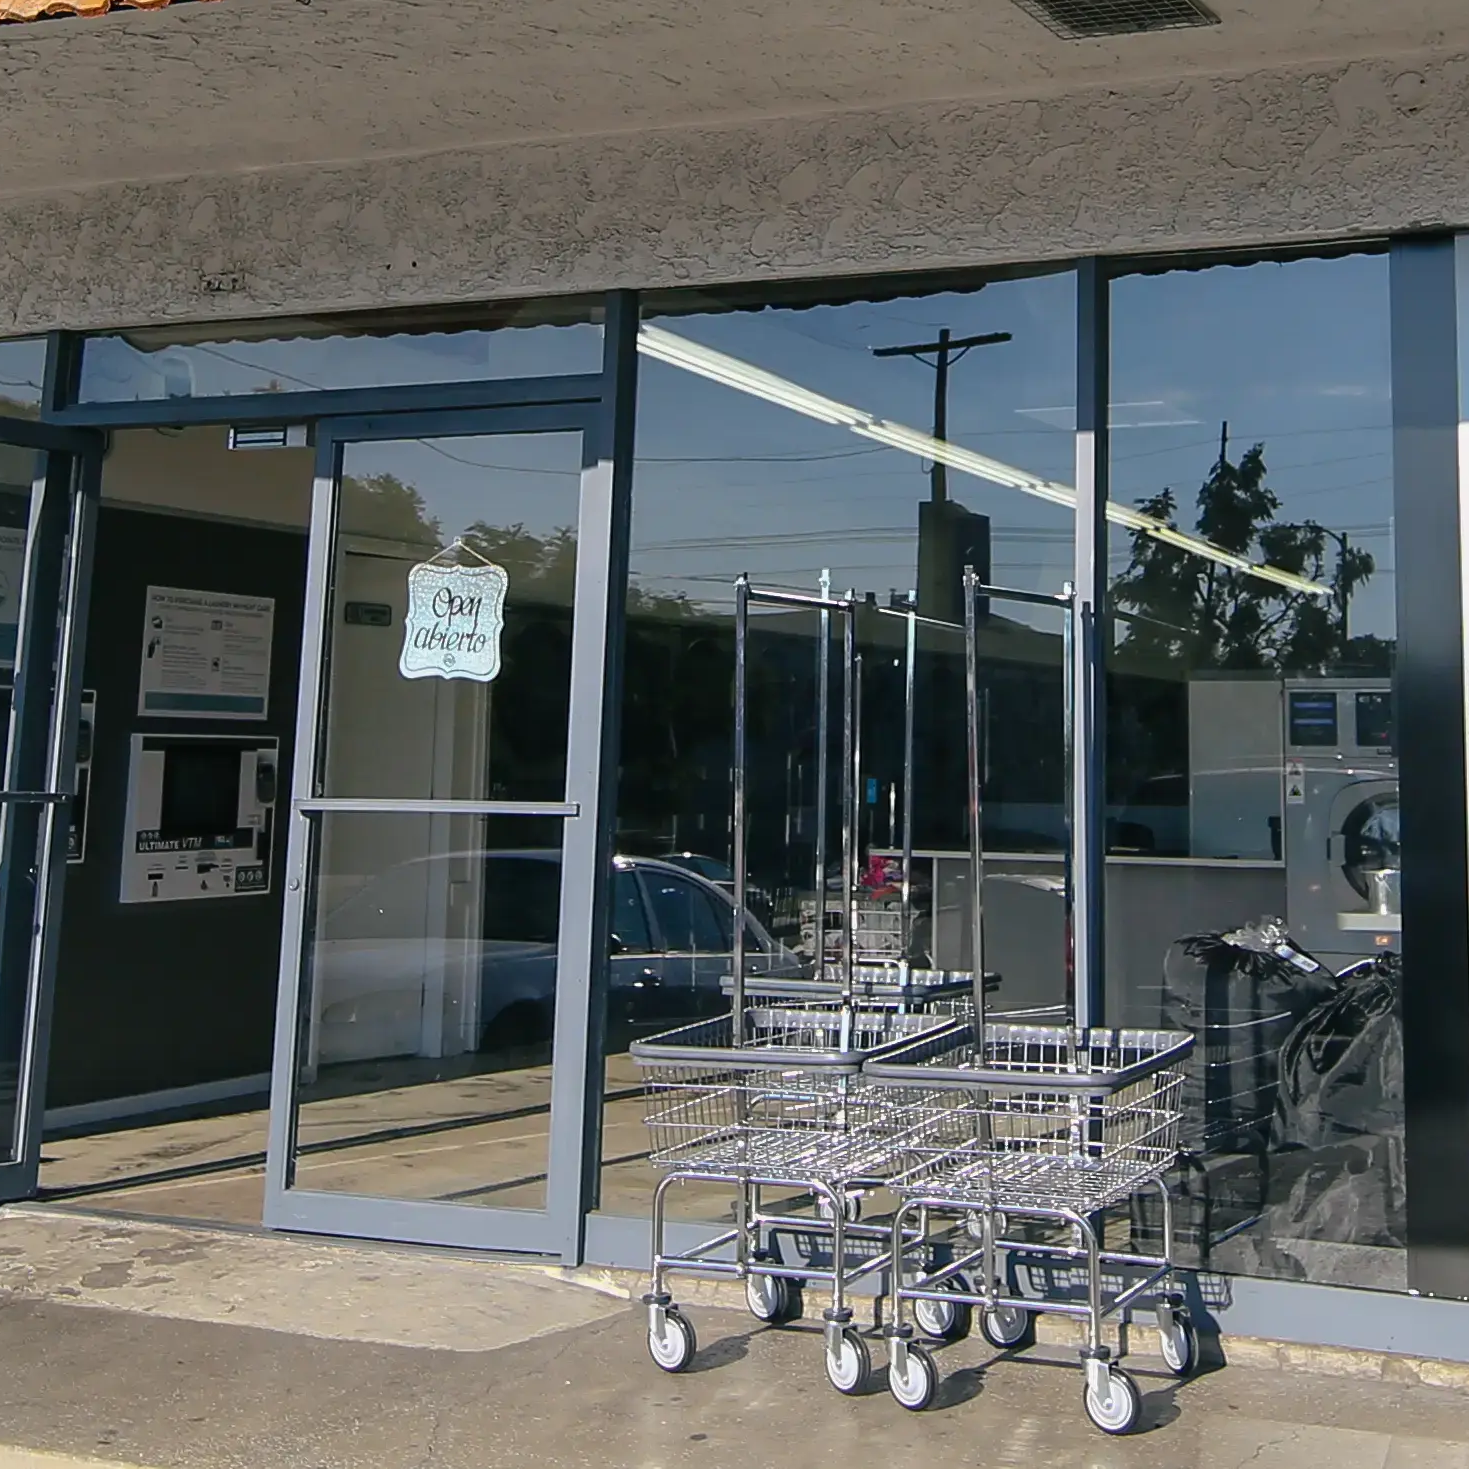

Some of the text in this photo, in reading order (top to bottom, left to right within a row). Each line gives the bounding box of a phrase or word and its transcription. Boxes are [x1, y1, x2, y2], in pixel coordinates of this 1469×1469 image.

[432, 586, 482, 630] Open
[413, 621, 487, 654] abierto
[138, 840, 179, 852] ULTIMATE
[181, 836, 203, 849] VTM
